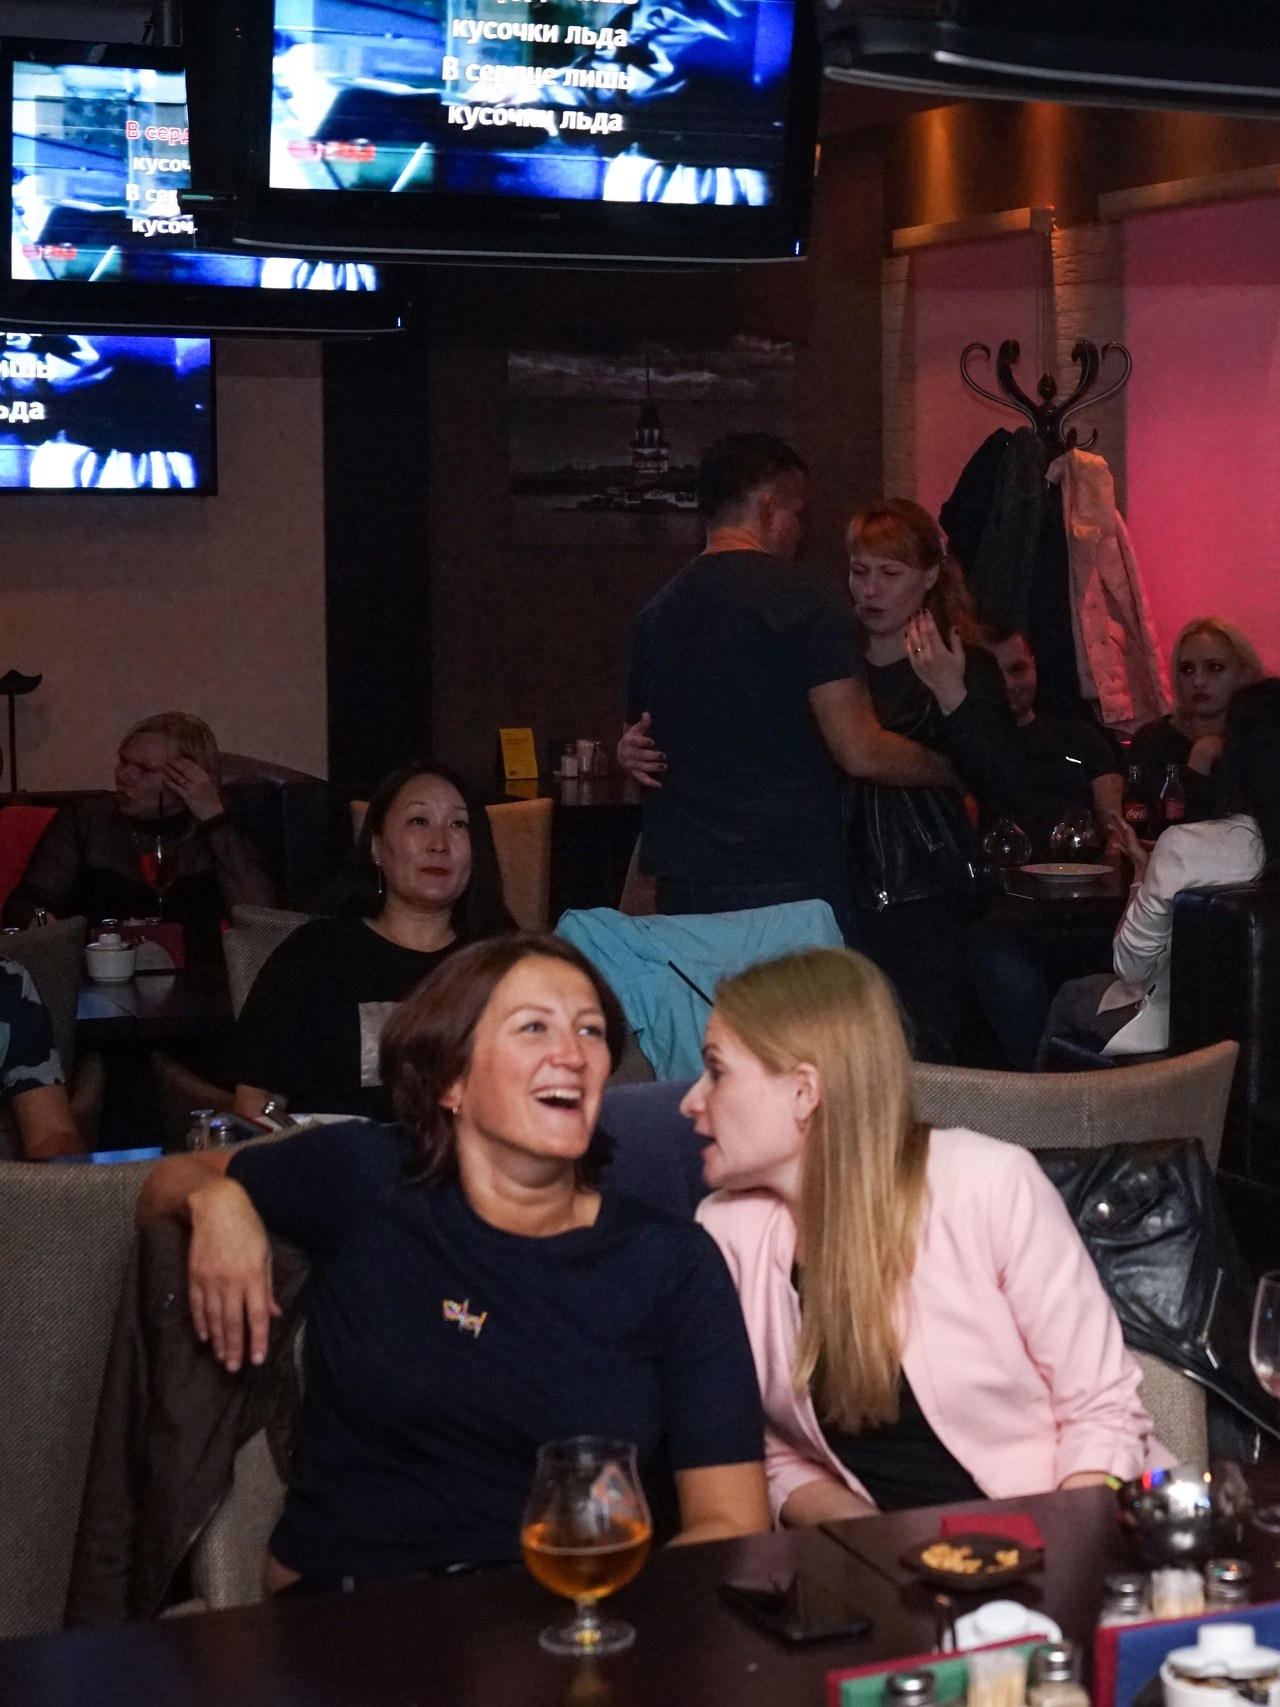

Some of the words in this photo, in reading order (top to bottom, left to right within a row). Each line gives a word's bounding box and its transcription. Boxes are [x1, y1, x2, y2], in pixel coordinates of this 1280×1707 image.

[452, 18, 559, 44] кусочки
[564, 25, 628, 49] льда
[441, 55, 459, 80] В
[465, 62, 558, 89] сердце
[562, 67, 634, 90] лишь
[126, 120, 140, 140] В
[448, 105, 556, 130] кусочки
[559, 110, 624, 134] льда
[125, 183, 140, 201] В
